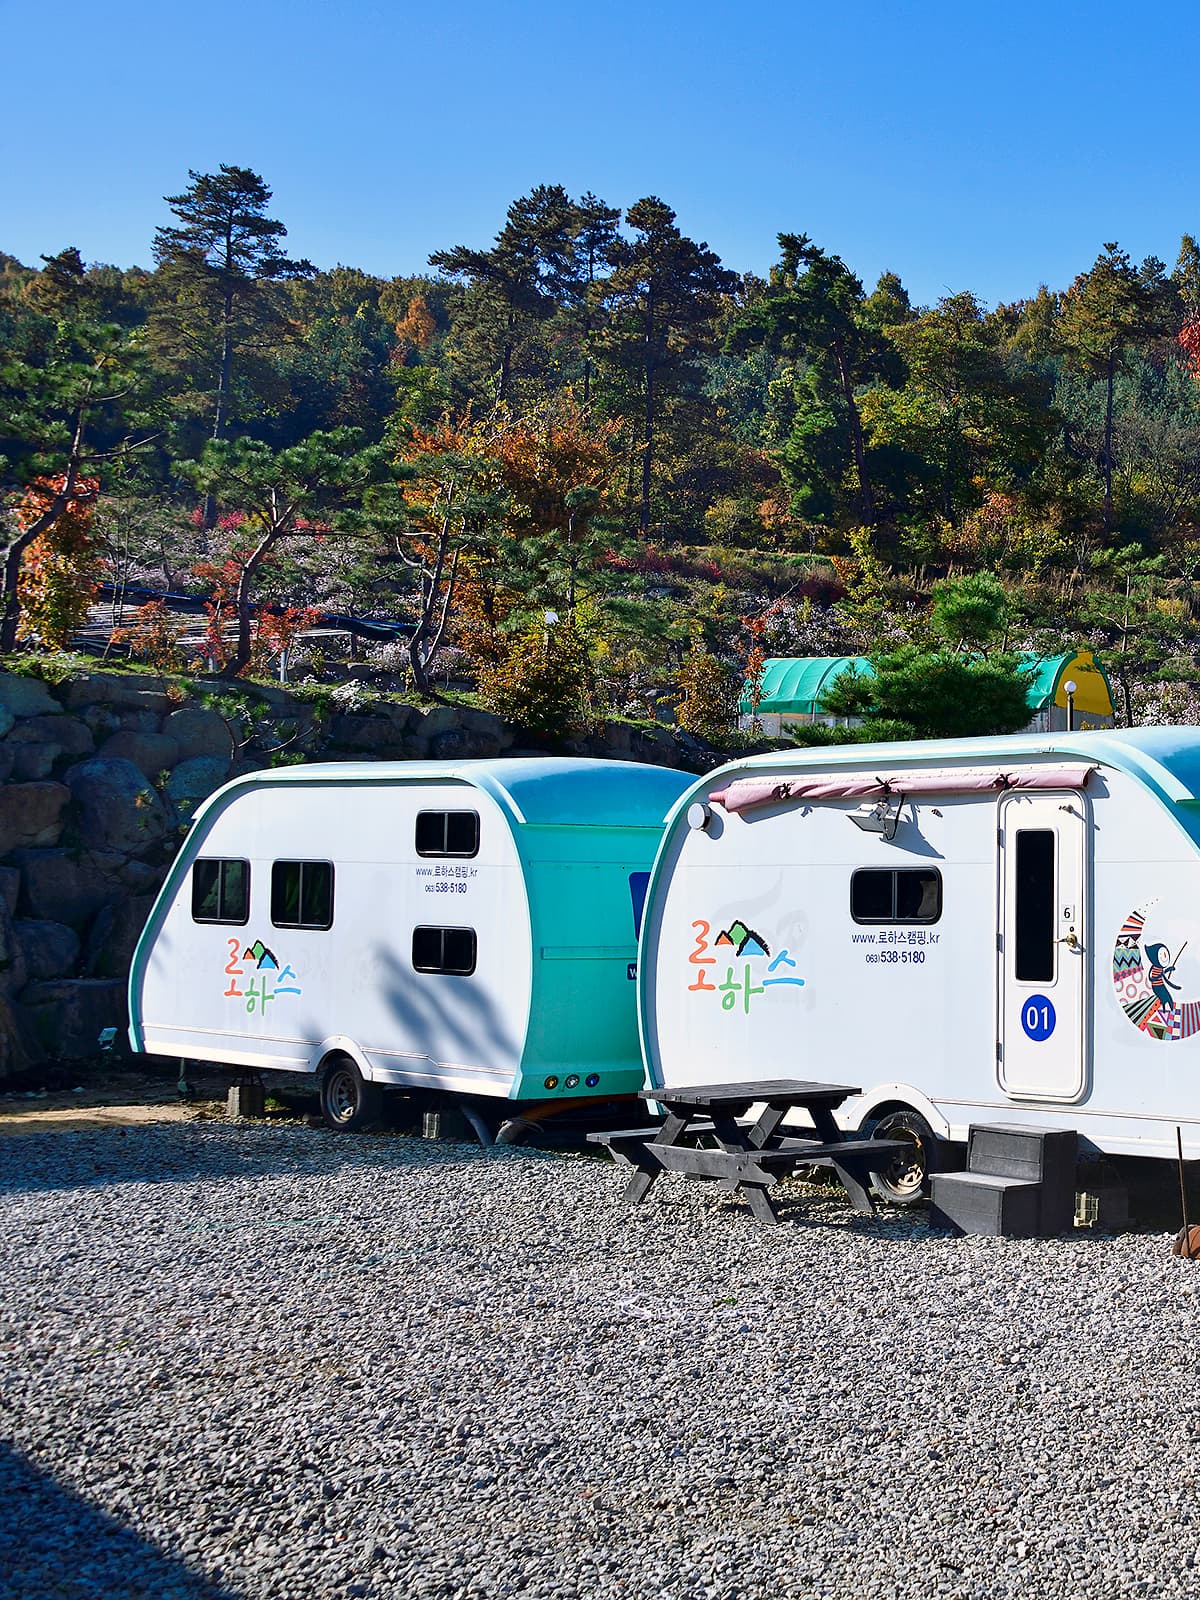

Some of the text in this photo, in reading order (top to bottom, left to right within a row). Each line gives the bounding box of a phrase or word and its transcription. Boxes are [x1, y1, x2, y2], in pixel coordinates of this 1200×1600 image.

[1063, 907, 1071, 919] 6
[851, 930, 941, 945] www.로하스캠핑.kr
[224, 938, 302, 1017] 로하스
[687, 919, 806, 1015] 로하스
[1026, 1006, 1049, 1031] 01
